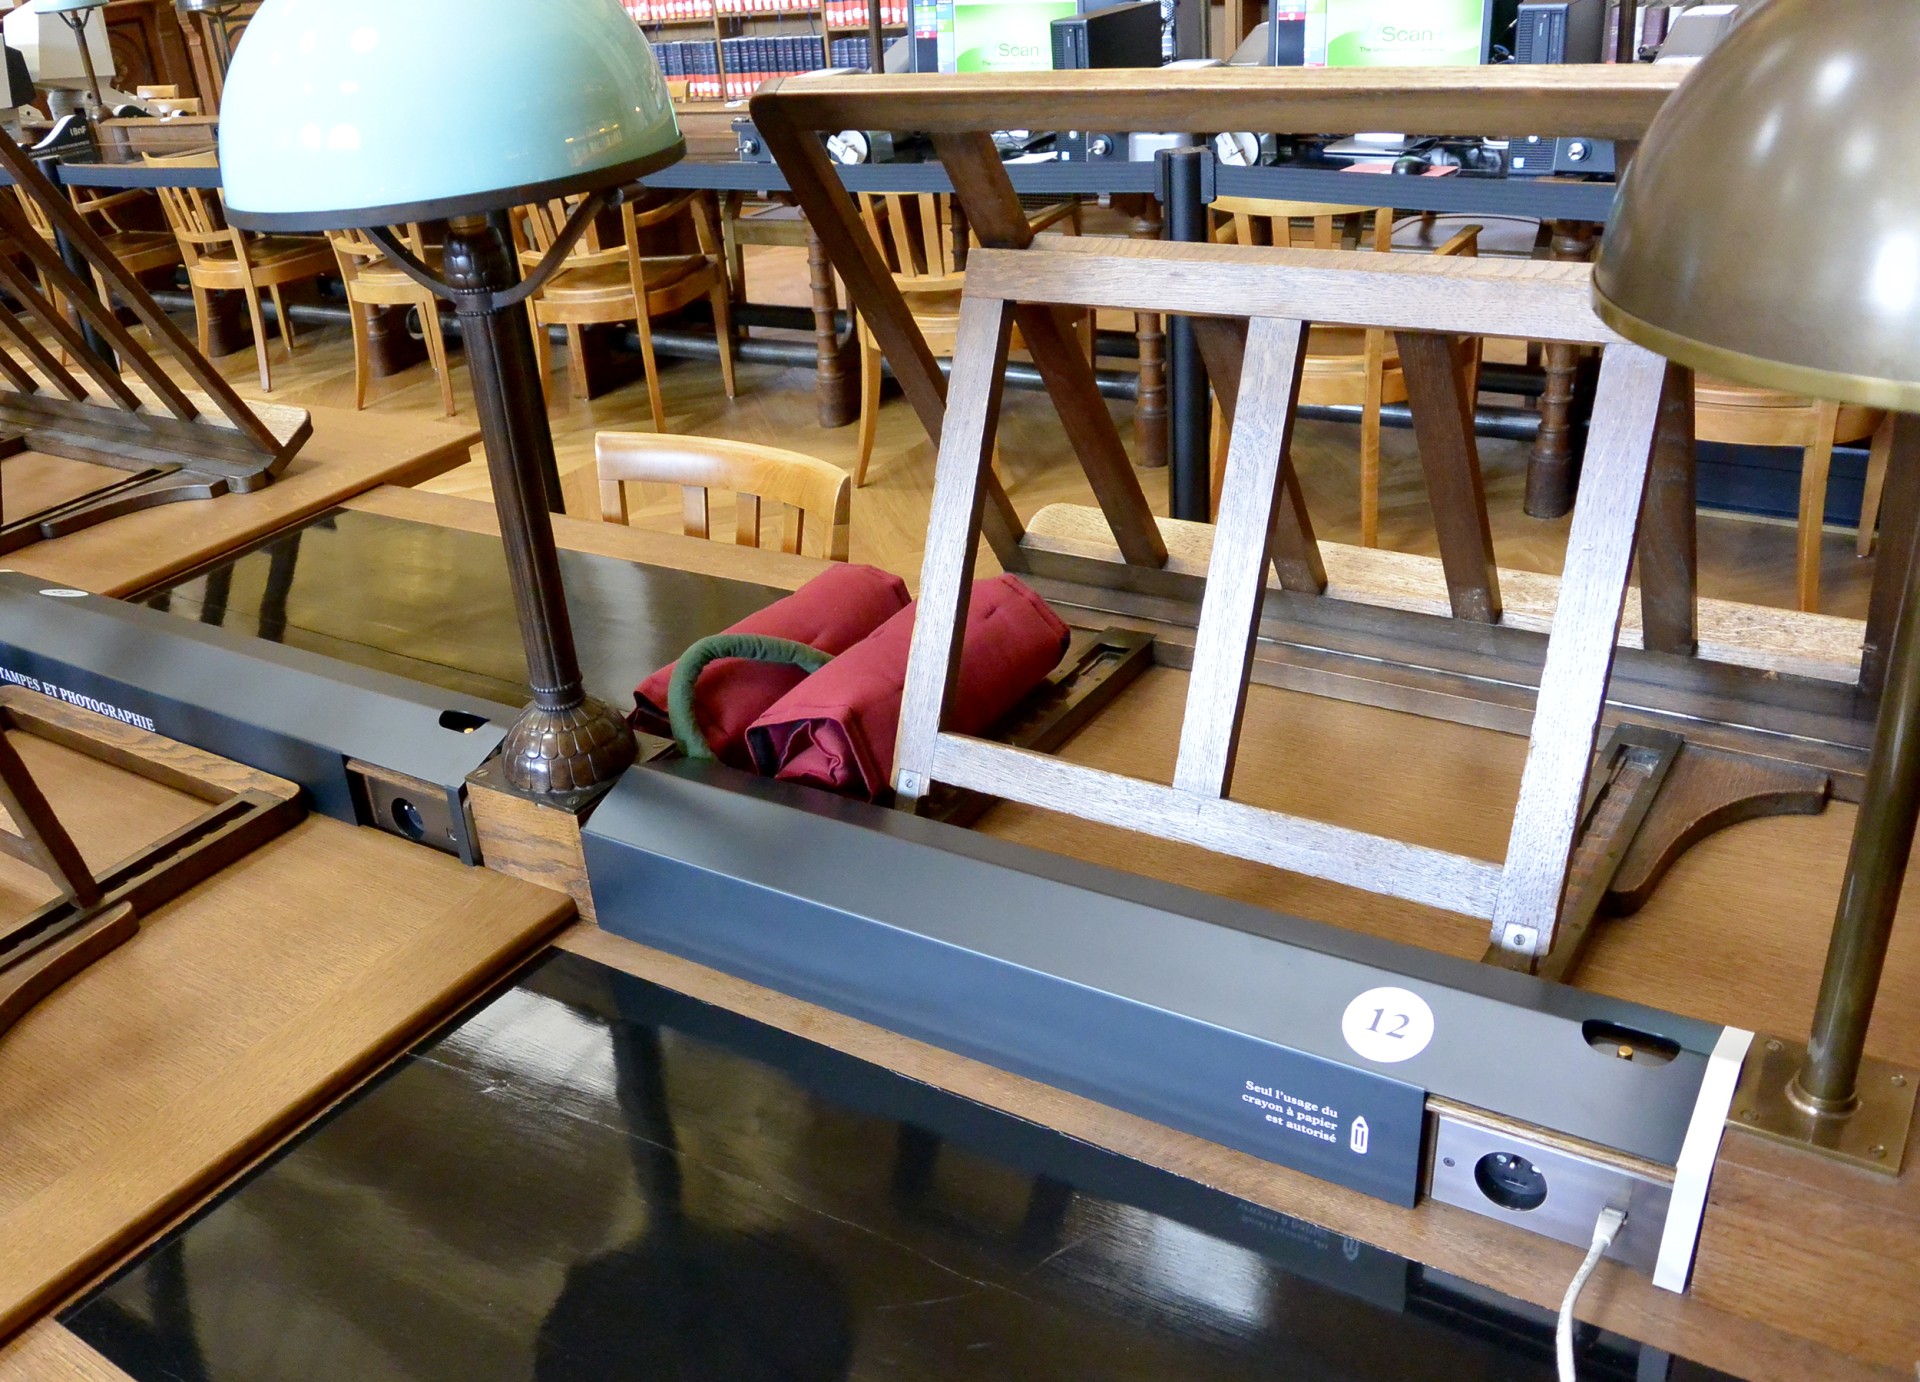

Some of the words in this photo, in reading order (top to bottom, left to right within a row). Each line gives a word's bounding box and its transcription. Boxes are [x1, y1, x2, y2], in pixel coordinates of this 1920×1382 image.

[1382, 26, 1433, 42] Scan
[998, 43, 1039, 57] Scan
[42, 681, 58, 697] ET
[59, 687, 156, 732] PHOTOGRAPHIE
[1365, 1008, 1410, 1039] 12
[1241, 1093, 1284, 1113] crayon
[1285, 1106, 1294, 1117] à
[1296, 1111, 1338, 1131] papier
[1245, 1080, 1273, 1097] Seul
[1321, 1105, 1338, 1119] du
[1265, 1113, 1284, 1126] est
[1285, 1120, 1337, 1143] autorisé
